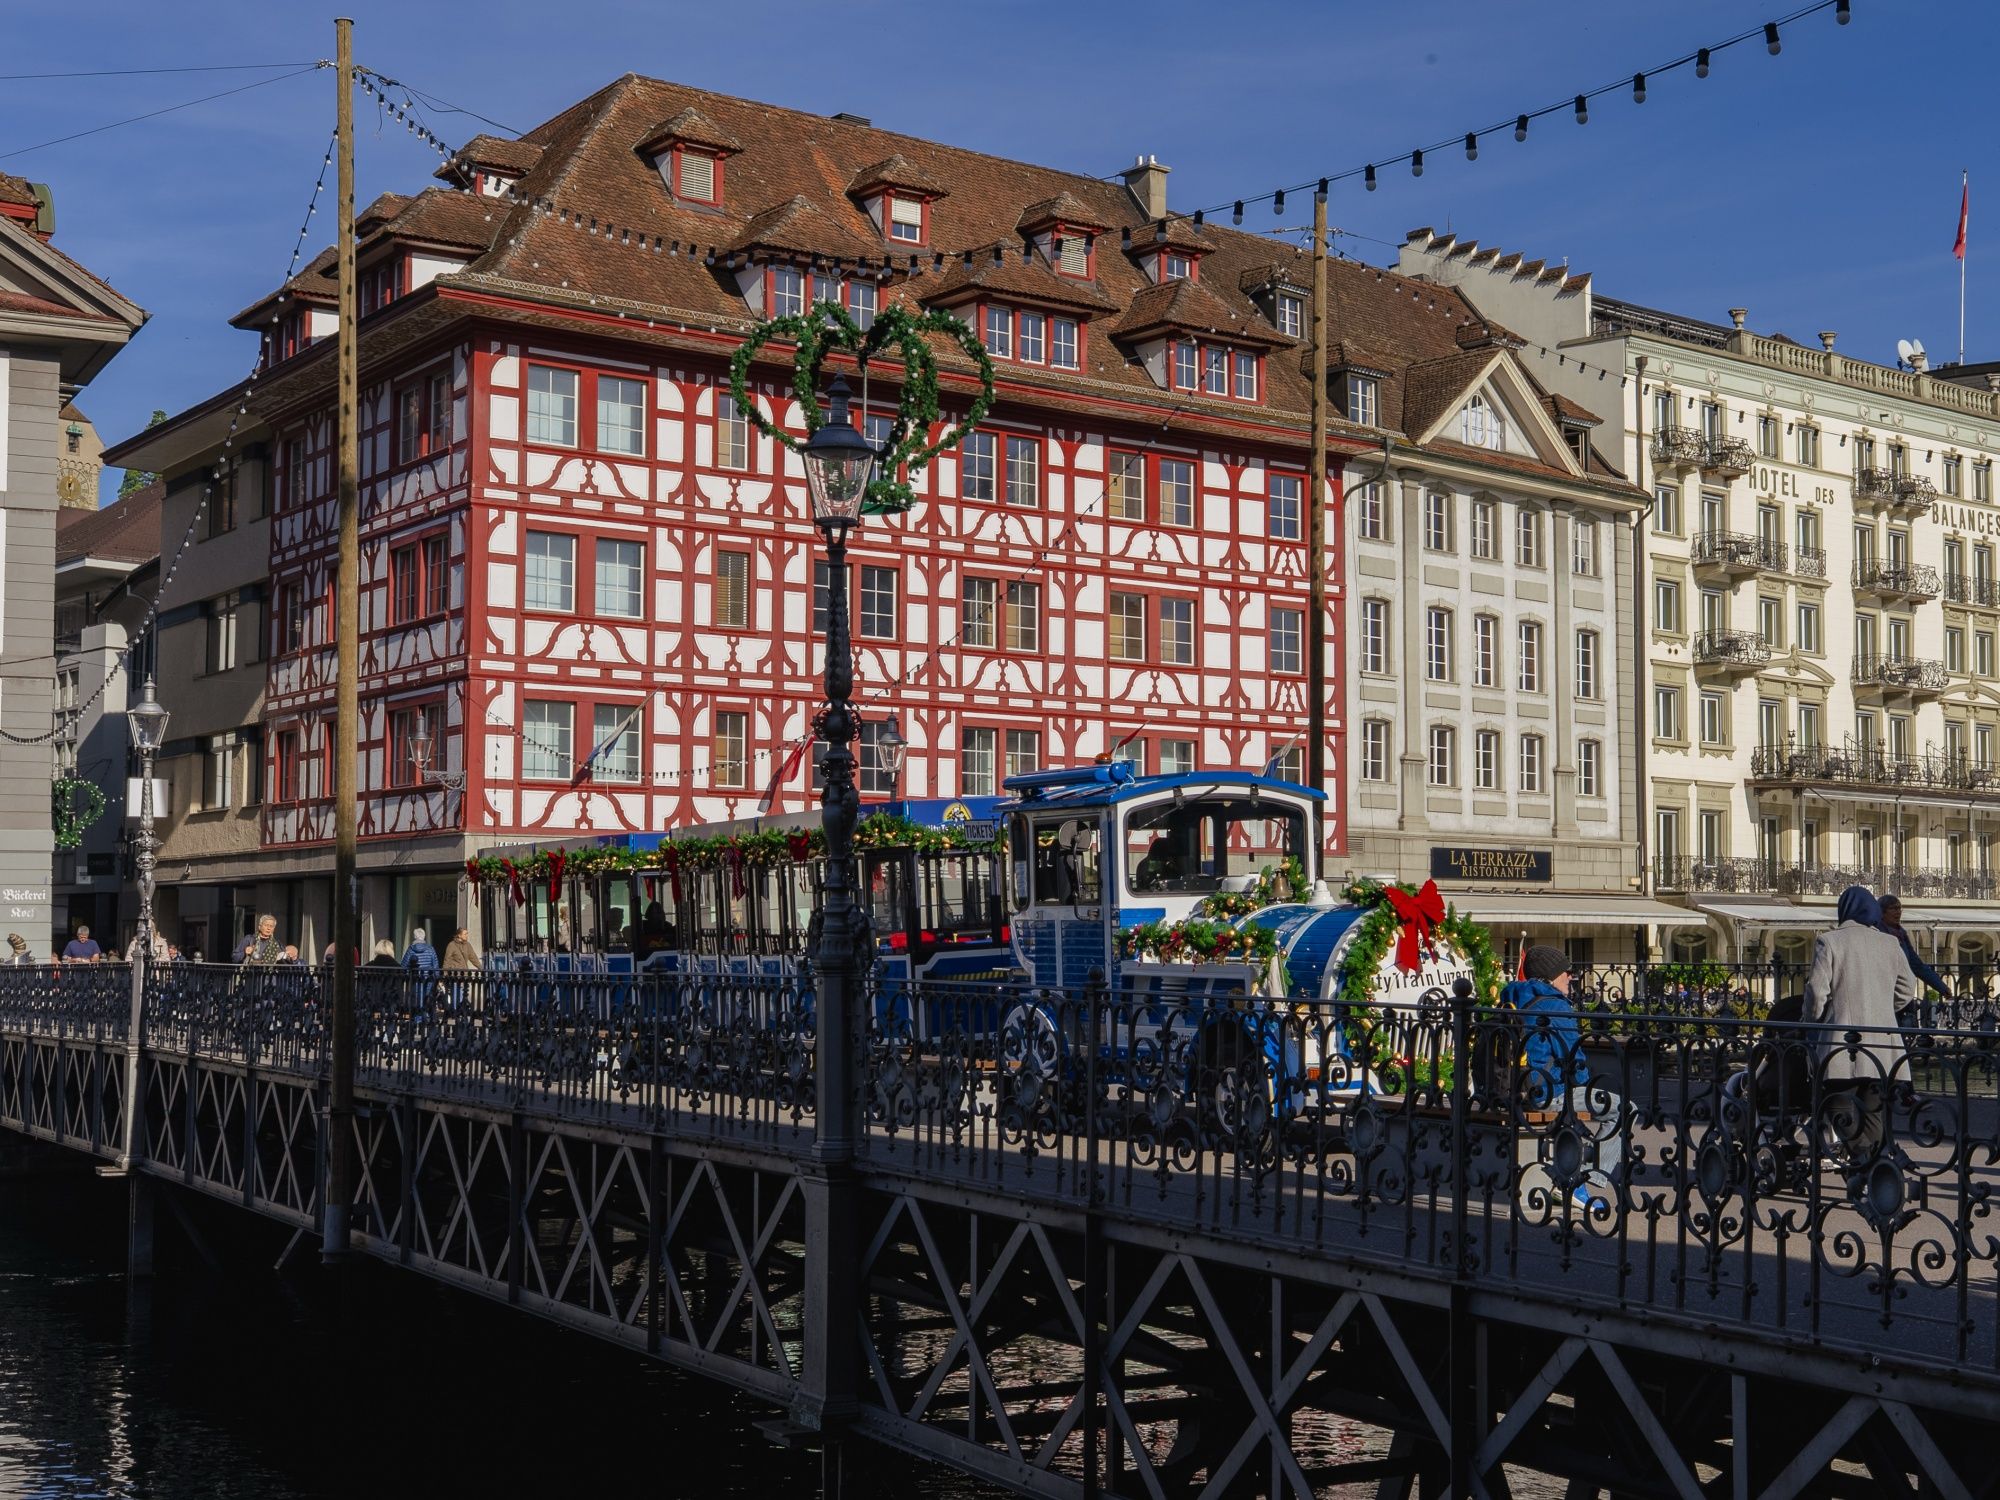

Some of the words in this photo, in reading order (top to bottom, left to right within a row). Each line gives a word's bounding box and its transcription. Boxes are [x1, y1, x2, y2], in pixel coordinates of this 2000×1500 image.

[1748, 465, 1799, 498] HOTEL
[1815, 486, 1835, 505] DES
[1931, 502, 2000, 537] BALANCES
[965, 824, 994, 839] TICKETS
[1450, 850, 1468, 866] LA
[1471, 851, 1537, 868] TERRAZZA
[1461, 866, 1528, 878] RISTORANTE
[2, 888, 46, 901] Bäckerei
